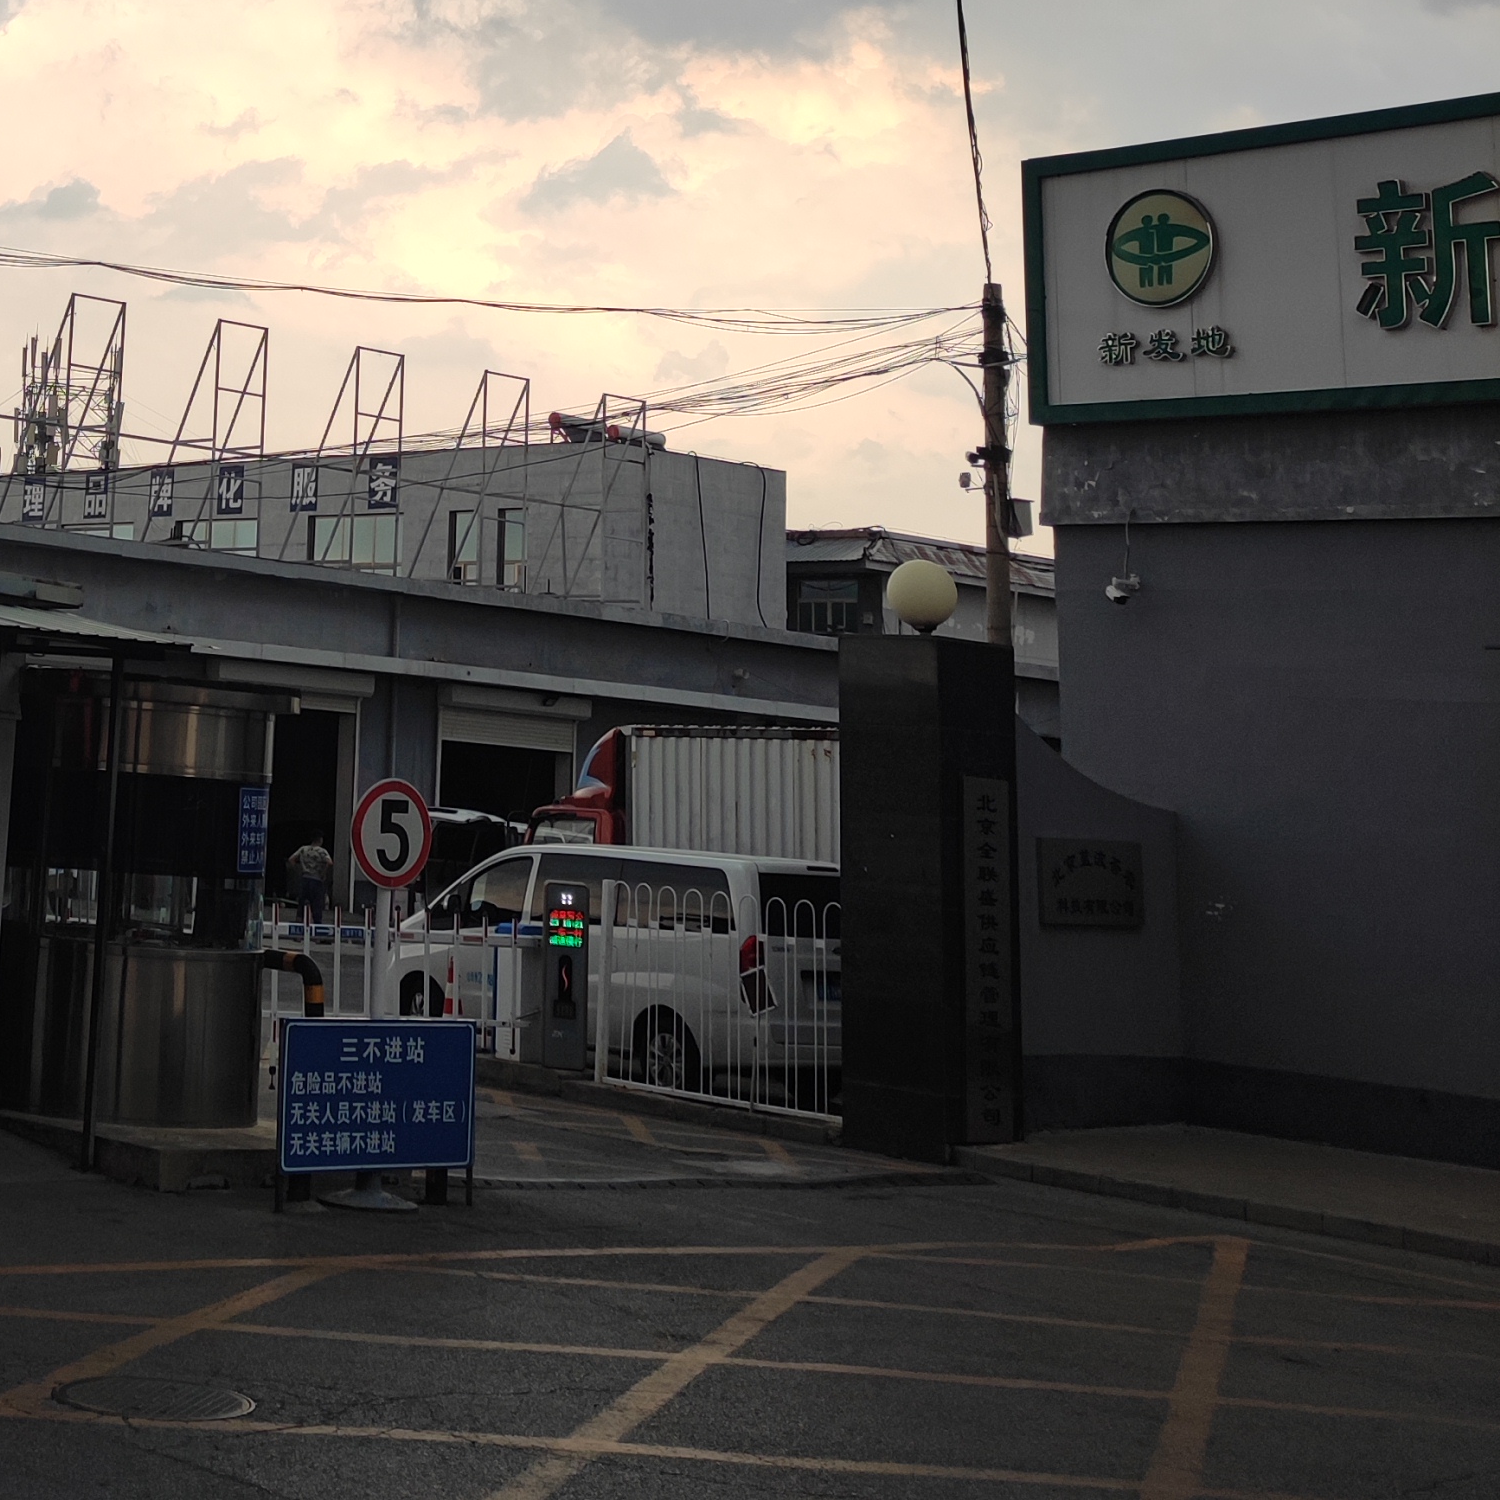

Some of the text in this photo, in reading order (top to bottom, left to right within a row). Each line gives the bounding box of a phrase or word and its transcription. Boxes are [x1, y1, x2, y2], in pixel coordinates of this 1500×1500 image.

[1354, 171, 1500, 330] 新
[1097, 325, 1235, 366] 新发地
[376, 799, 409, 872] 5
[339, 1036, 426, 1064] 三不进站
[290, 1071, 383, 1095] 危险品不进站
[290, 1130, 396, 1156] 无关车辆不进站
